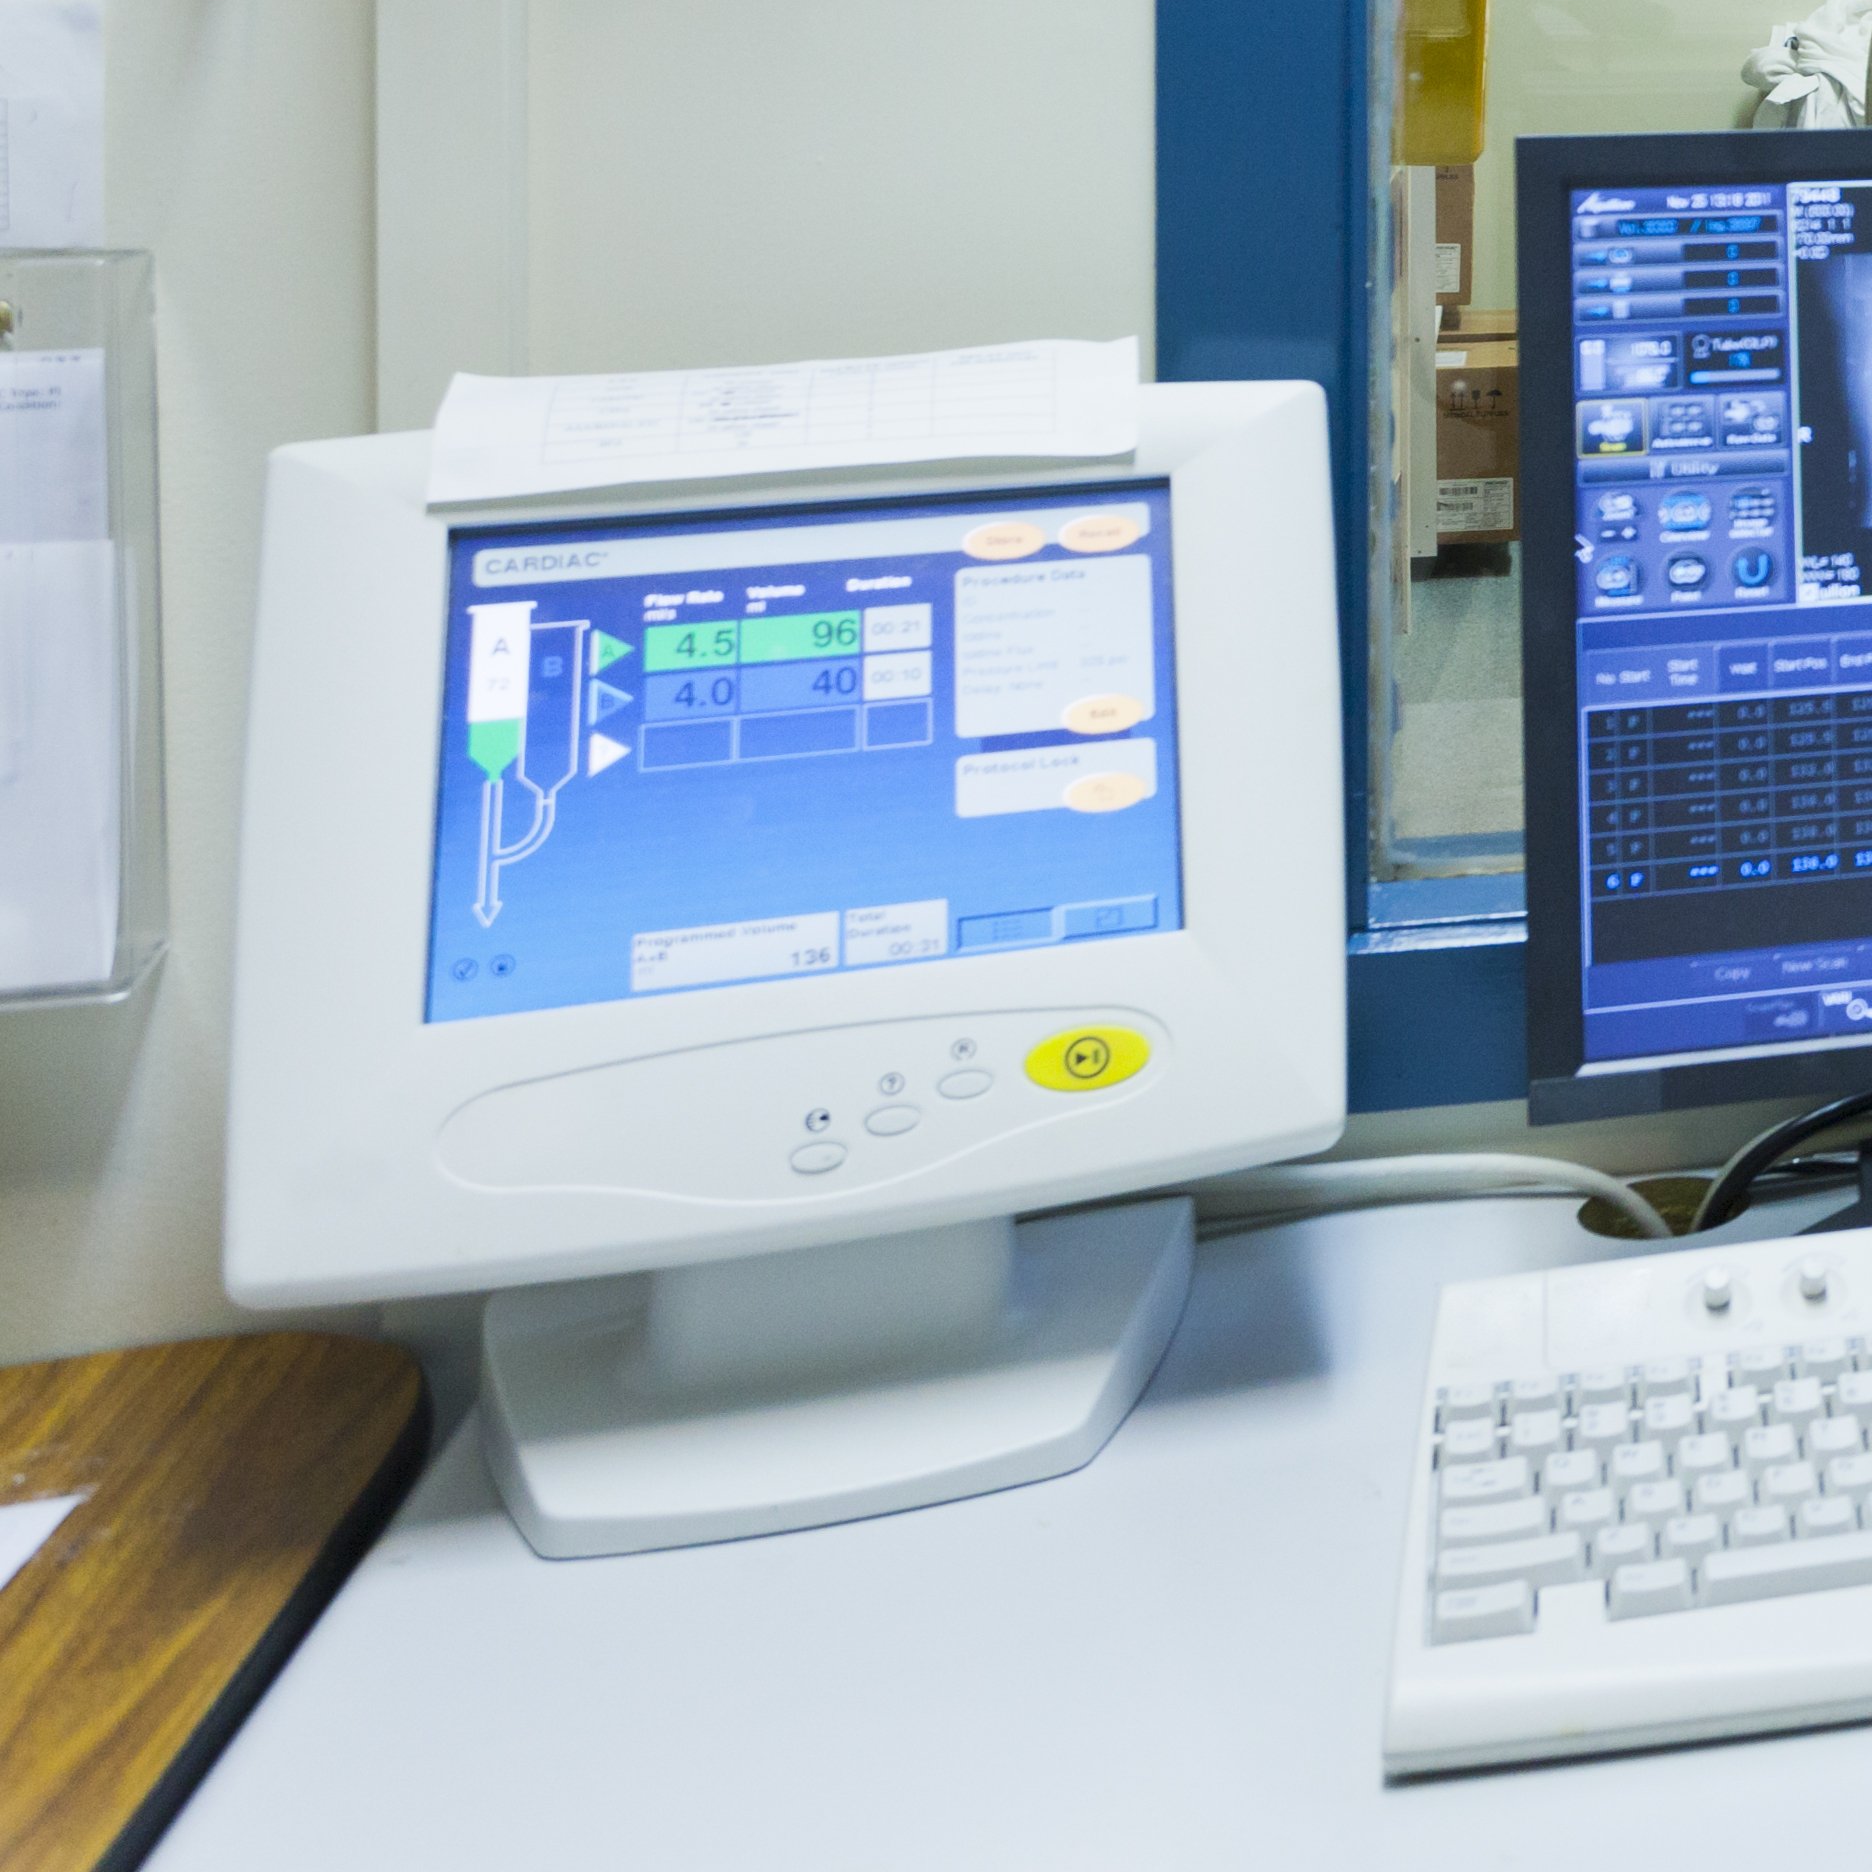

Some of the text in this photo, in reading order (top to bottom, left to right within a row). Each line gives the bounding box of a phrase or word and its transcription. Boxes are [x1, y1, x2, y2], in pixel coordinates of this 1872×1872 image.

[1671, 462, 1719, 477] Utility
[962, 572, 1046, 588] Procedure
[643, 589, 724, 609] Flow Rate
[745, 583, 806, 601] Volume
[492, 638, 511, 656] A
[676, 630, 736, 659] 4.5
[811, 618, 858, 650] 96
[541, 656, 563, 678] B
[674, 678, 733, 708] 4.0
[811, 666, 857, 696] 40
[962, 759, 1036, 776] Protocol
[789, 948, 831, 967] 136
